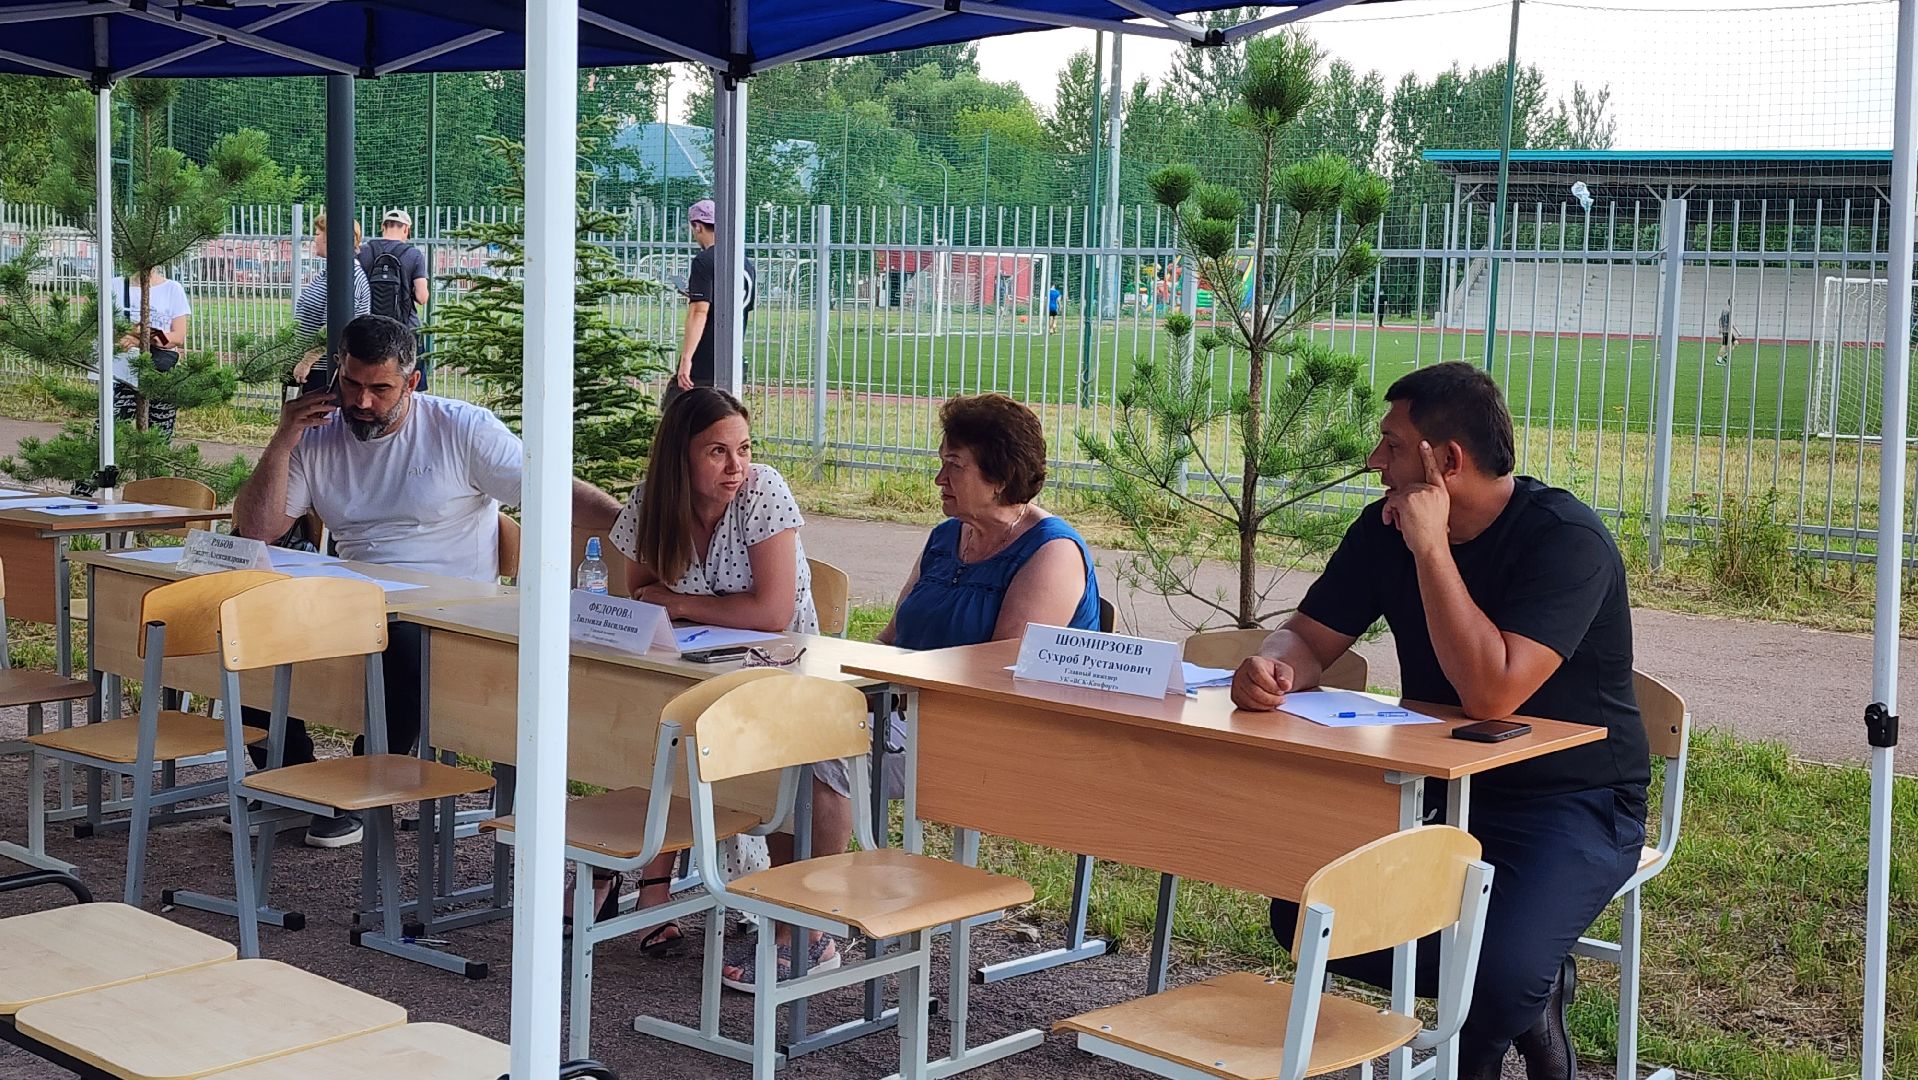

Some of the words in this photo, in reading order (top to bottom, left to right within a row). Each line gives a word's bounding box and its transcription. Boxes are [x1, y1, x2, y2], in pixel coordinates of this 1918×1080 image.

[211, 538, 234, 550] РЯБОВ
[588, 602, 633, 619] ФЕДОРОВА
[603, 619, 638, 634] Васильевна
[1055, 633, 1143, 656] ШОМИРЗОЕВ
[1038, 648, 1080, 665] Сухроб
[1082, 655, 1153, 676] Рустамович
